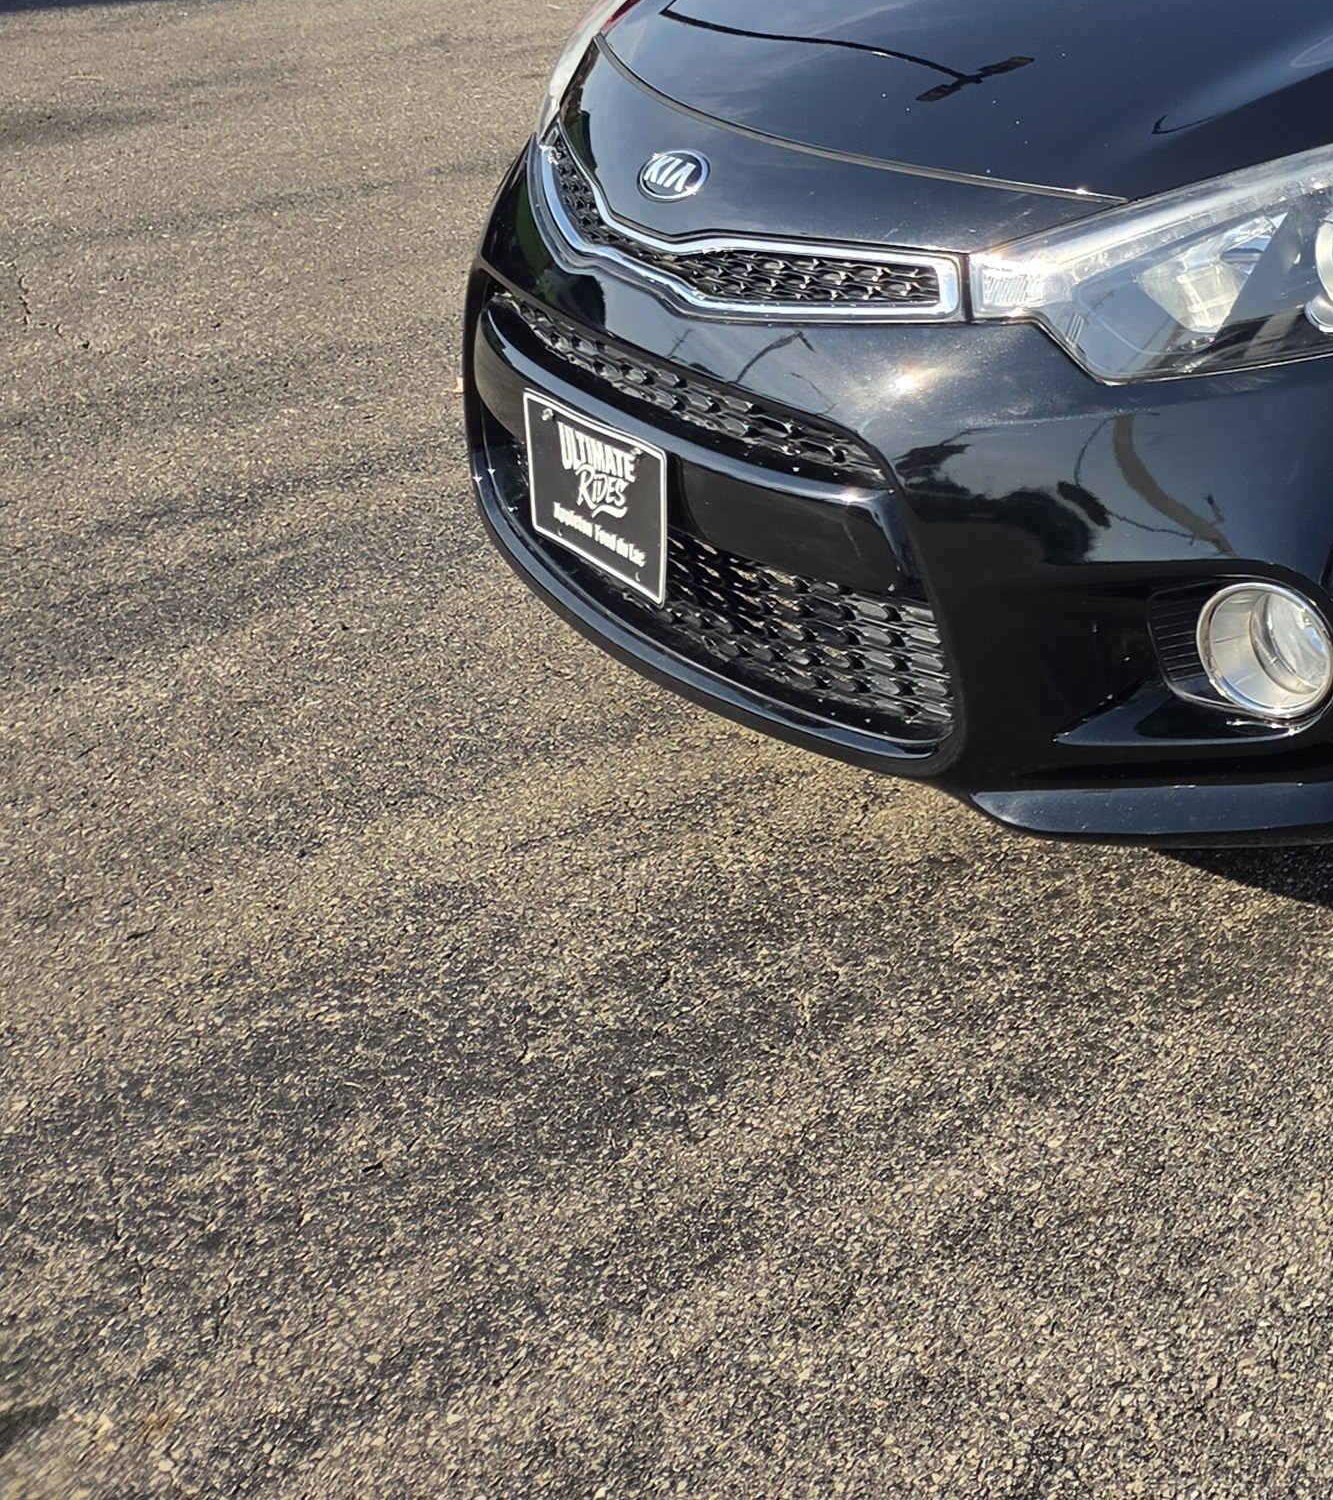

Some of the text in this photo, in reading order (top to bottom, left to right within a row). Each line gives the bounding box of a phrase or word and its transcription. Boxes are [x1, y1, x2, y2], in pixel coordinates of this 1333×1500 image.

[643, 155, 697, 193] KIA
[557, 421, 636, 483] ULTIMATE
[575, 464, 630, 514] RIDES
[553, 501, 593, 538] Appleton
